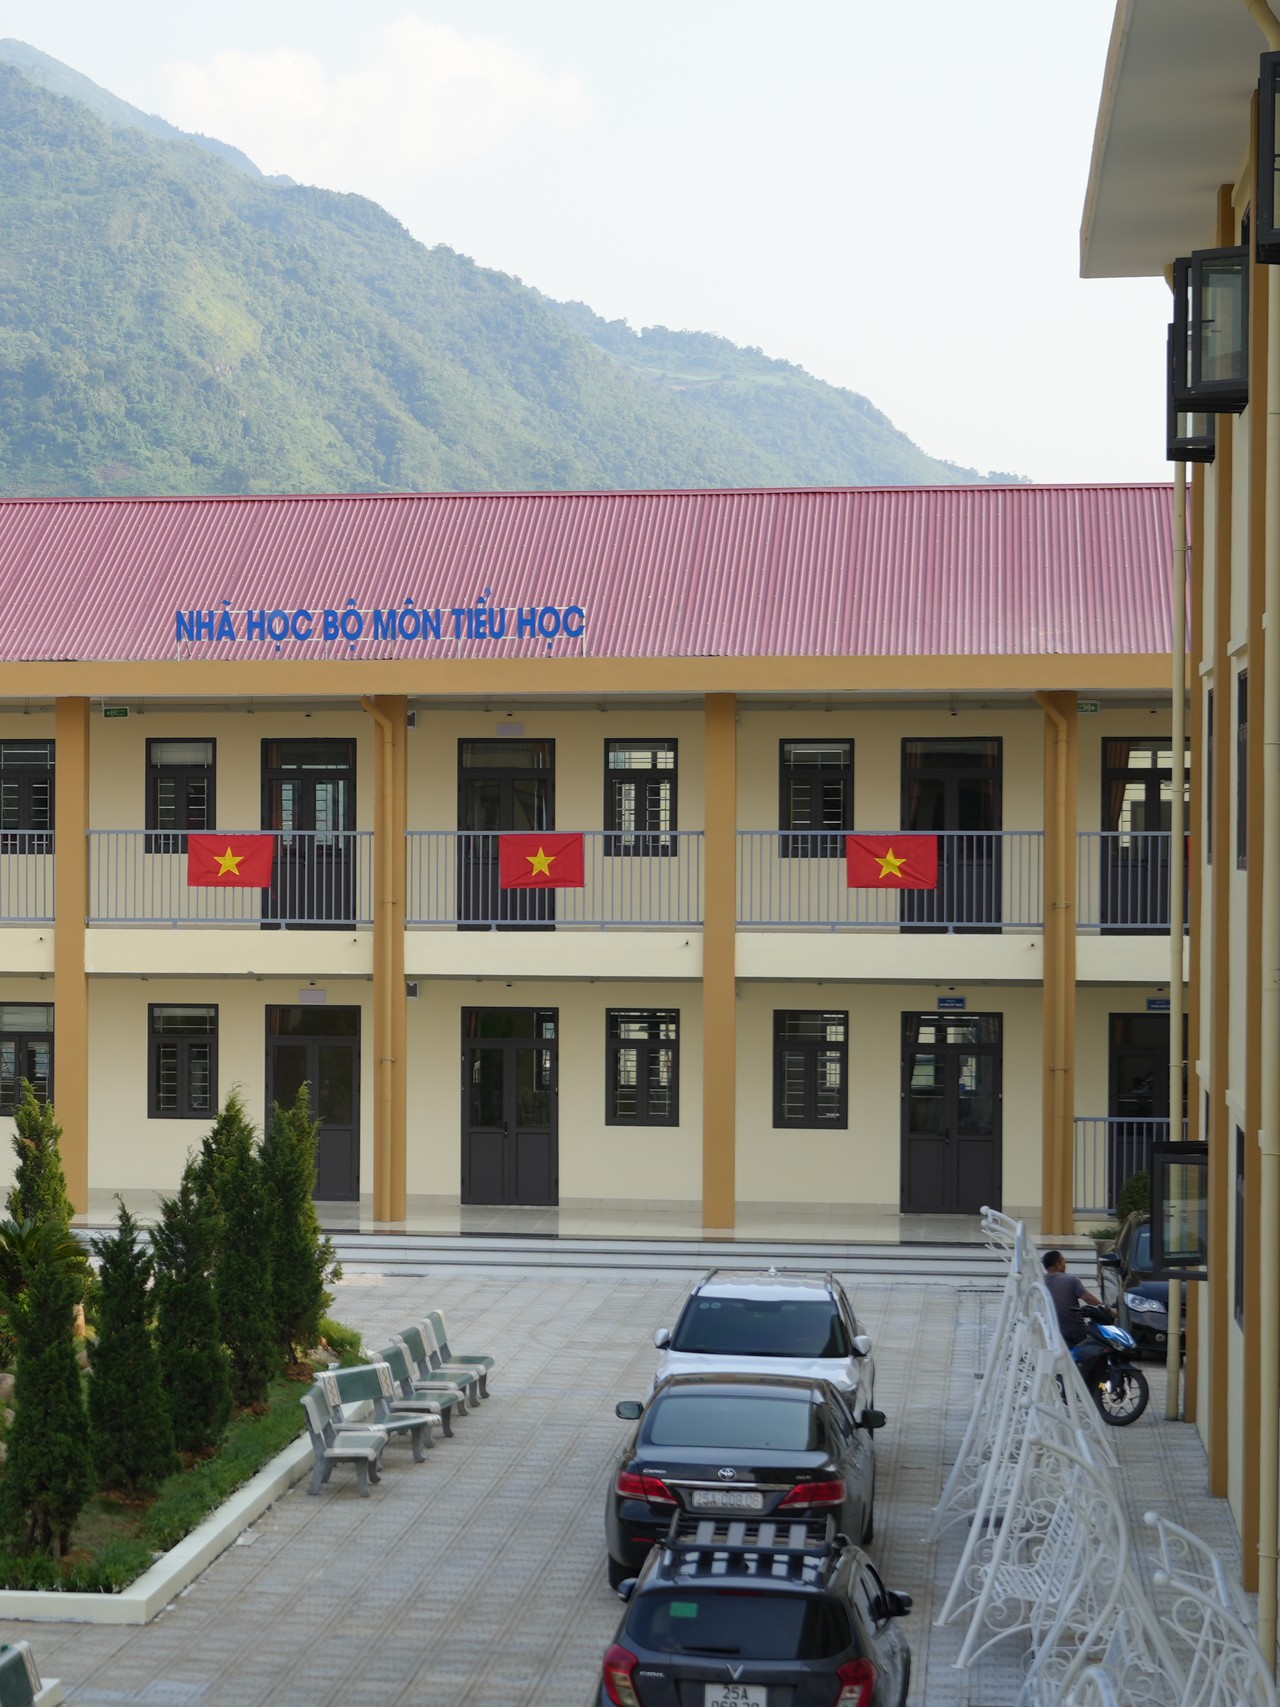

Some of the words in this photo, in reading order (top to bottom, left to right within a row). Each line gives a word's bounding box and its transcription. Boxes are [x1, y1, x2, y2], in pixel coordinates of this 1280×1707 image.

[176, 599, 236, 641] NHÀ
[247, 609, 313, 651] HỌC
[323, 598, 363, 651] BỘ
[373, 597, 441, 640] MÔN
[452, 586, 505, 640] TIỂU
[518, 605, 586, 649] HỌC
[722, 1685, 748, 1700] 25A
